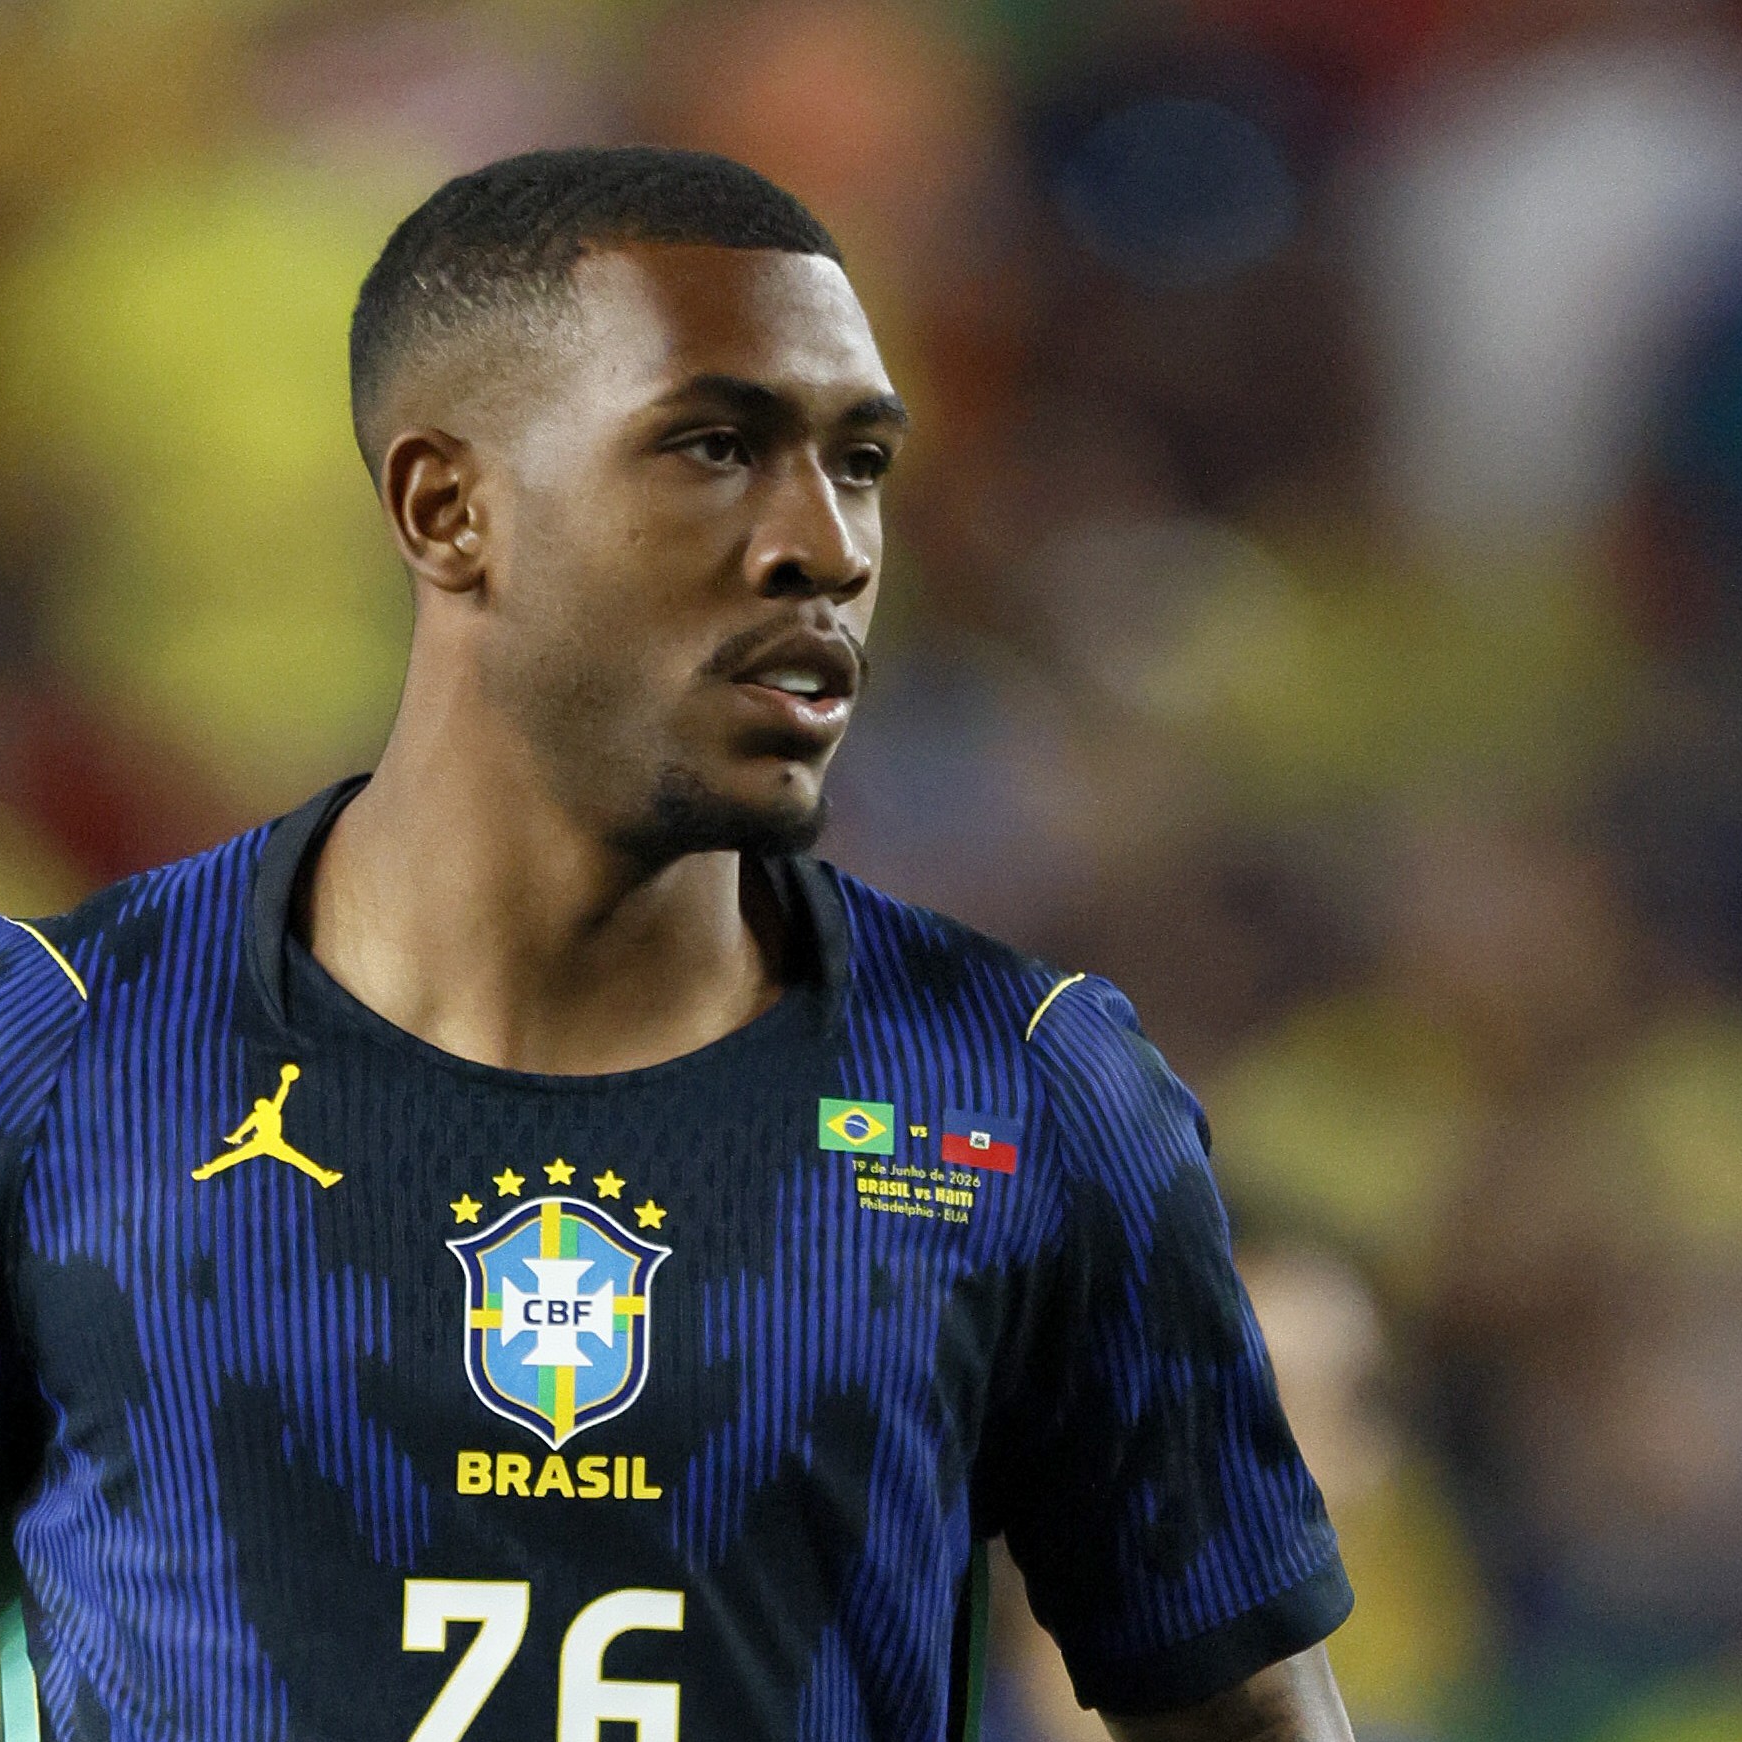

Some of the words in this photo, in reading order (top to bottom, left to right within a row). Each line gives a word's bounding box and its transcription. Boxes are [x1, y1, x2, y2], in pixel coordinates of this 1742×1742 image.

[909, 1125, 928, 1138] vs
[852, 1160, 867, 1172] 19
[870, 1161, 887, 1175] de
[929, 1168, 945, 1181] de
[949, 1171, 981, 1188] 2026
[914, 1187, 931, 1201] vs
[860, 1196, 934, 1218] Philadelphia
[944, 1208, 968, 1224] EUA
[523, 1299, 593, 1326] CBF
[457, 1452, 663, 1500] BRASIL
